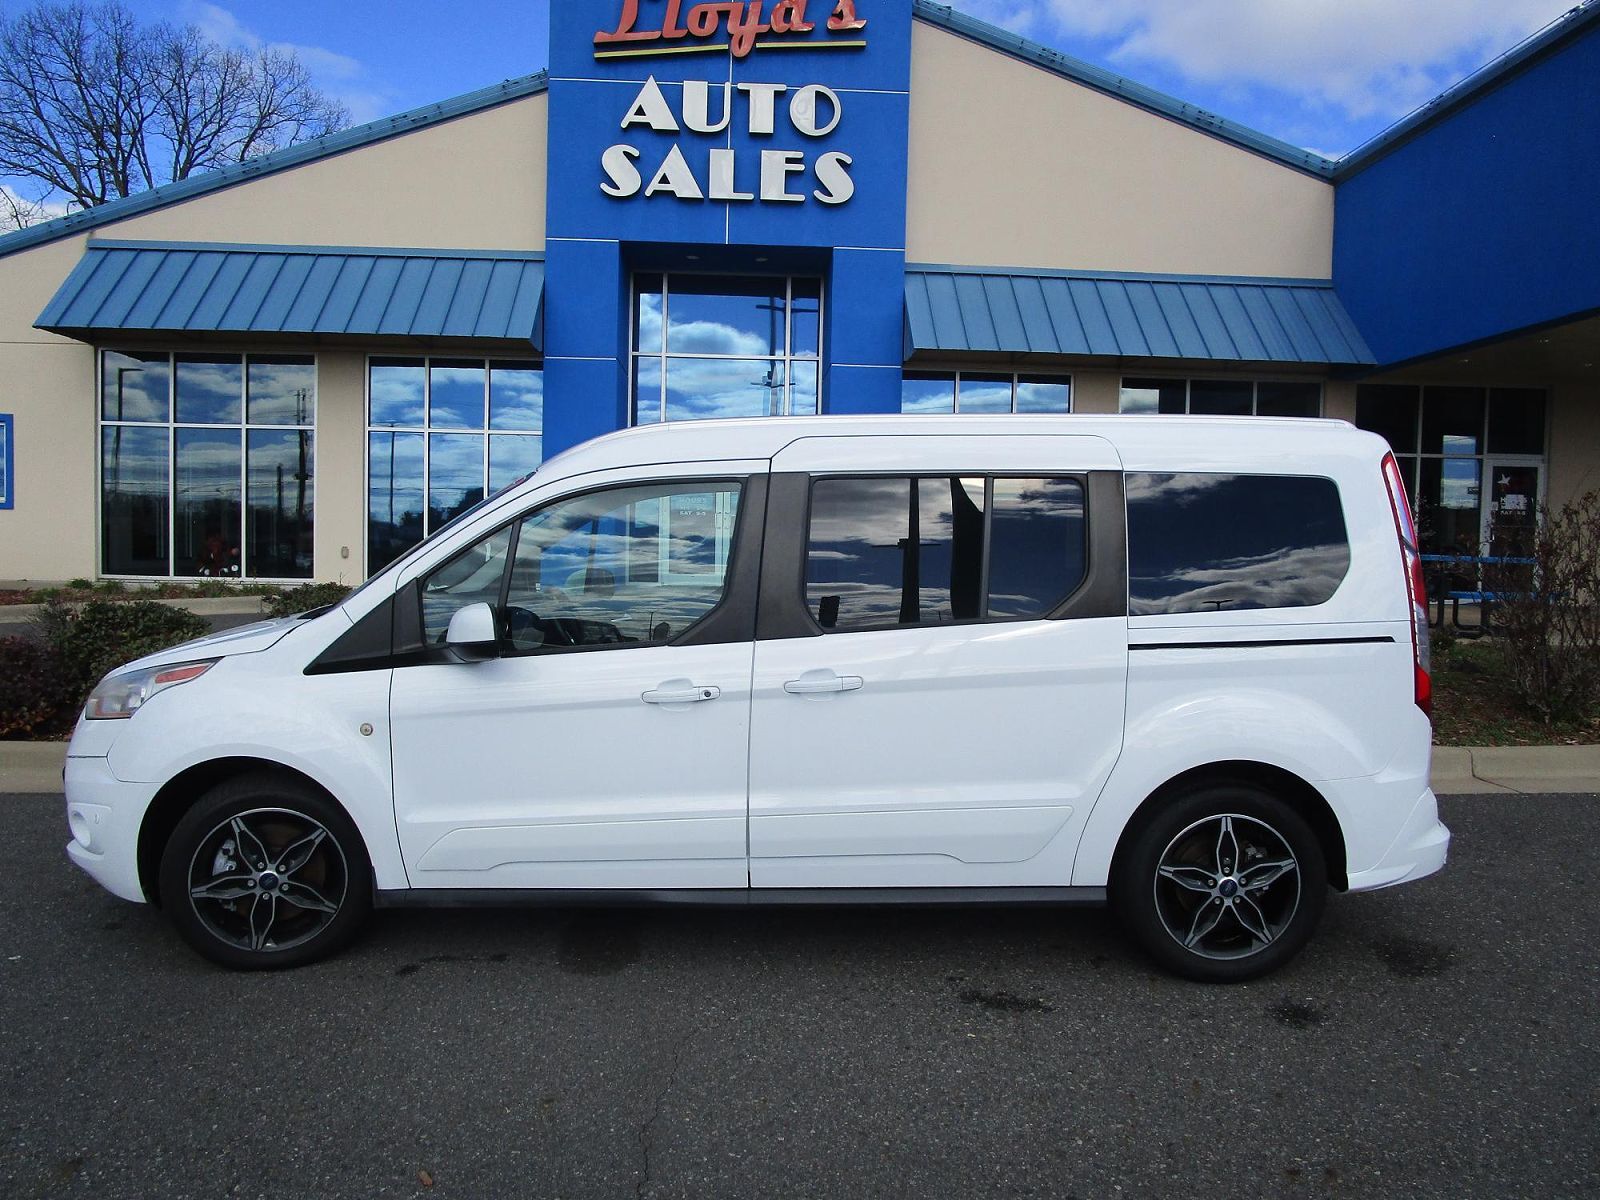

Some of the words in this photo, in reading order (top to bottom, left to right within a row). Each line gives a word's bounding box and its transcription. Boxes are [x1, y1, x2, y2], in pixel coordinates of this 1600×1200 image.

[593, 0, 867, 56] Lloyds
[621, 75, 842, 137] AUTO
[600, 143, 855, 204] SALES
